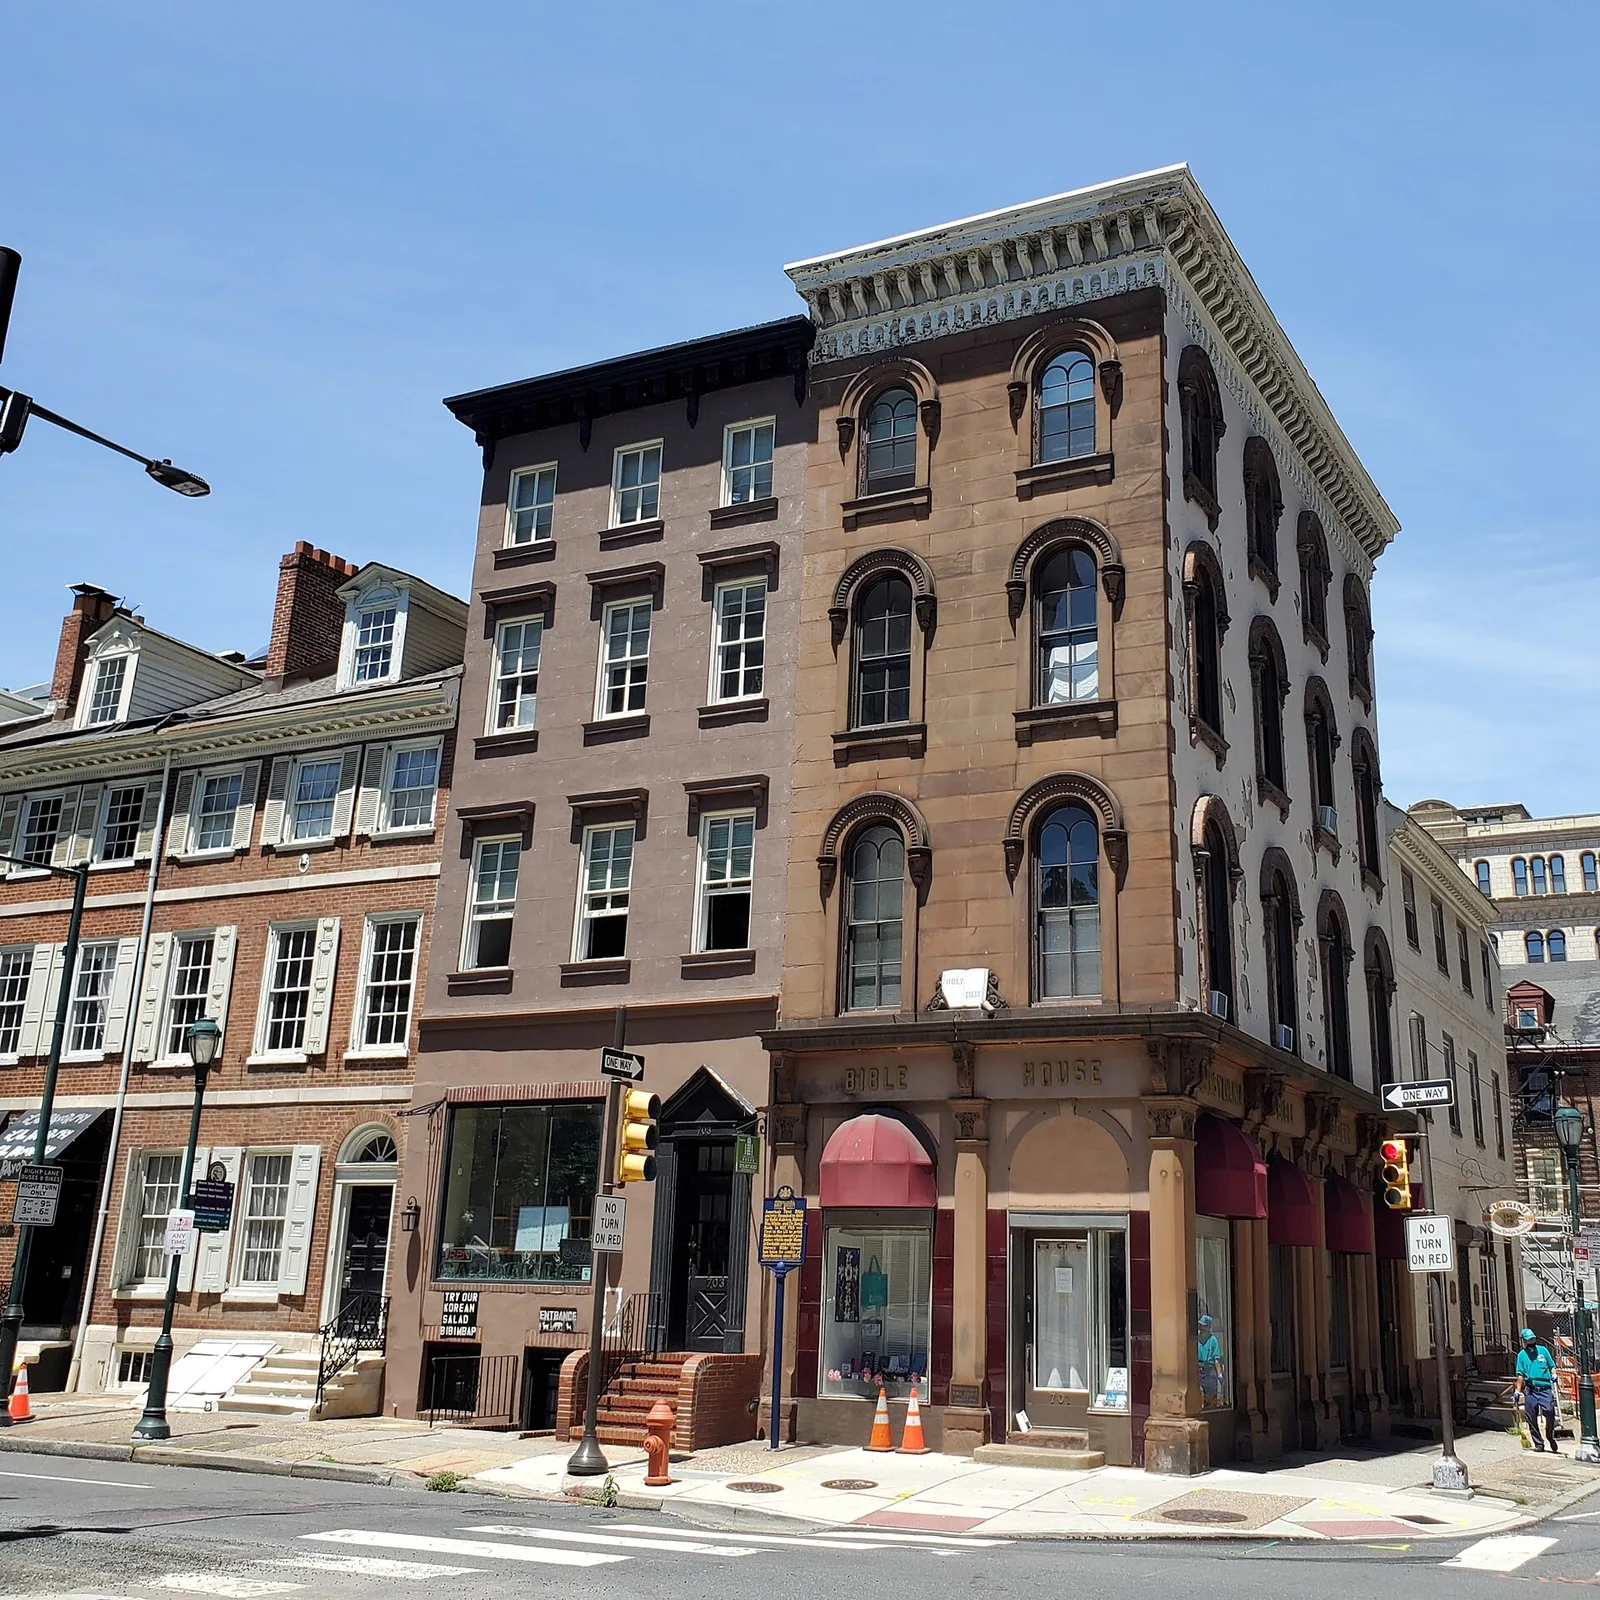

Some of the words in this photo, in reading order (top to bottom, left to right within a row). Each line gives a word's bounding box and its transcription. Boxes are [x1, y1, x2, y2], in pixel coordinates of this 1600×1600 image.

[606, 1056, 618, 1068] ONE
[619, 1060, 632, 1071] WAY
[845, 1066, 908, 1093] BIBLE
[1022, 1060, 1102, 1087] HOUSE
[1402, 1090, 1422, 1101] ONE
[1424, 1088, 1444, 1099] WAY
[605, 1203, 617, 1214] NO
[601, 1218, 619, 1230] TURN
[1419, 1223, 1435, 1234] NO
[595, 1233, 606, 1244] ON
[607, 1234, 622, 1246] RED
[1415, 1238, 1442, 1249] TURN
[1411, 1254, 1425, 1265] ON
[1428, 1253, 1449, 1266] RED
[707, 1278, 725, 1288] 703
[444, 1292, 460, 1302] TRY
[461, 1292, 478, 1302] OUR
[443, 1303, 475, 1313] KOREAN
[442, 1314, 469, 1324] SALAD
[540, 1310, 577, 1320] ENTRANCE
[440, 1326, 477, 1336] BIBIMBAP
